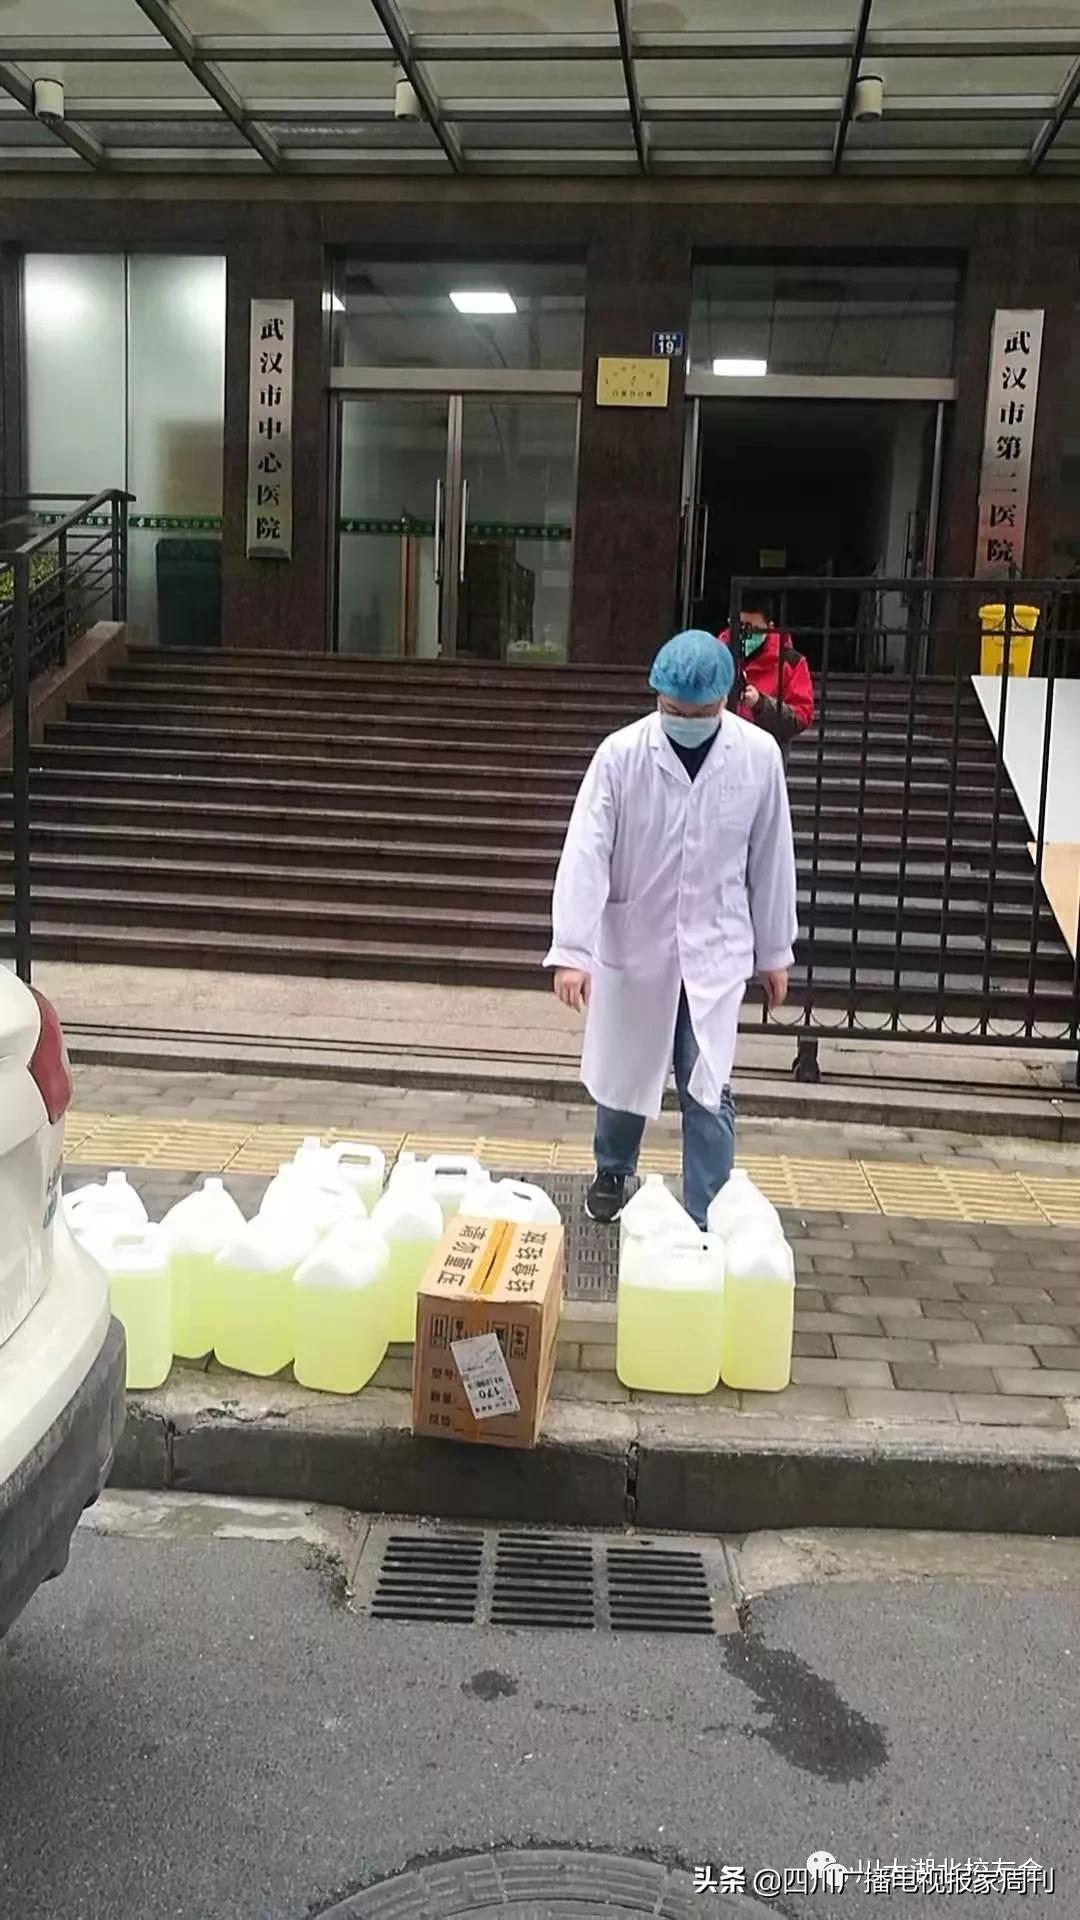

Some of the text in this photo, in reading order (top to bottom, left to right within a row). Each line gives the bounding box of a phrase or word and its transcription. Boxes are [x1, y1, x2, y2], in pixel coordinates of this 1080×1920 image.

[256, 317, 285, 540] 武汉市中心医院
[986, 330, 1031, 562] 武汉市第二医院
[505, 1229, 548, 1293] 轻拿轻放
